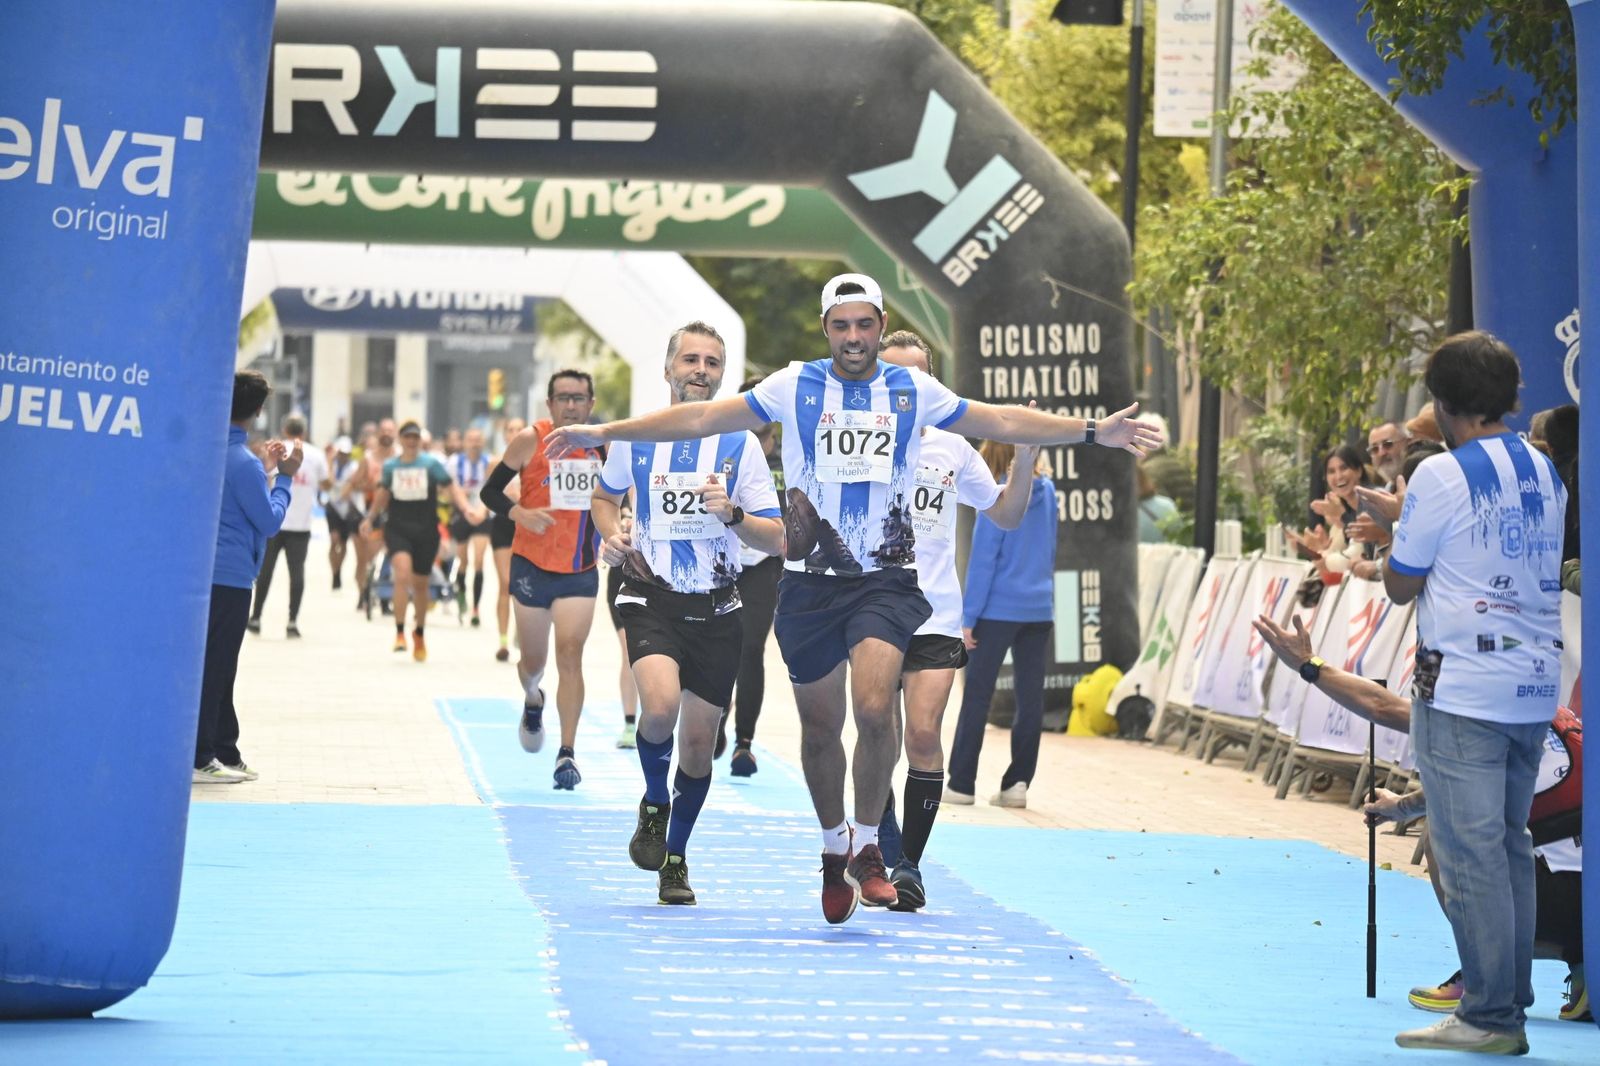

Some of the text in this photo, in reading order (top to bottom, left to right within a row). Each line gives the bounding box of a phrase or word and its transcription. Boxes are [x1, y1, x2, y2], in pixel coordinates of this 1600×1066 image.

[52, 201, 168, 241] original
[979, 322, 1101, 358] CICLISMO
[123, 362, 150, 386] de
[982, 359, 1099, 398] TRIATLÓN
[820, 429, 891, 457] 1072
[837, 467, 872, 477] Huelva
[914, 486, 945, 514] 04
[669, 525, 705, 535] Huelva
